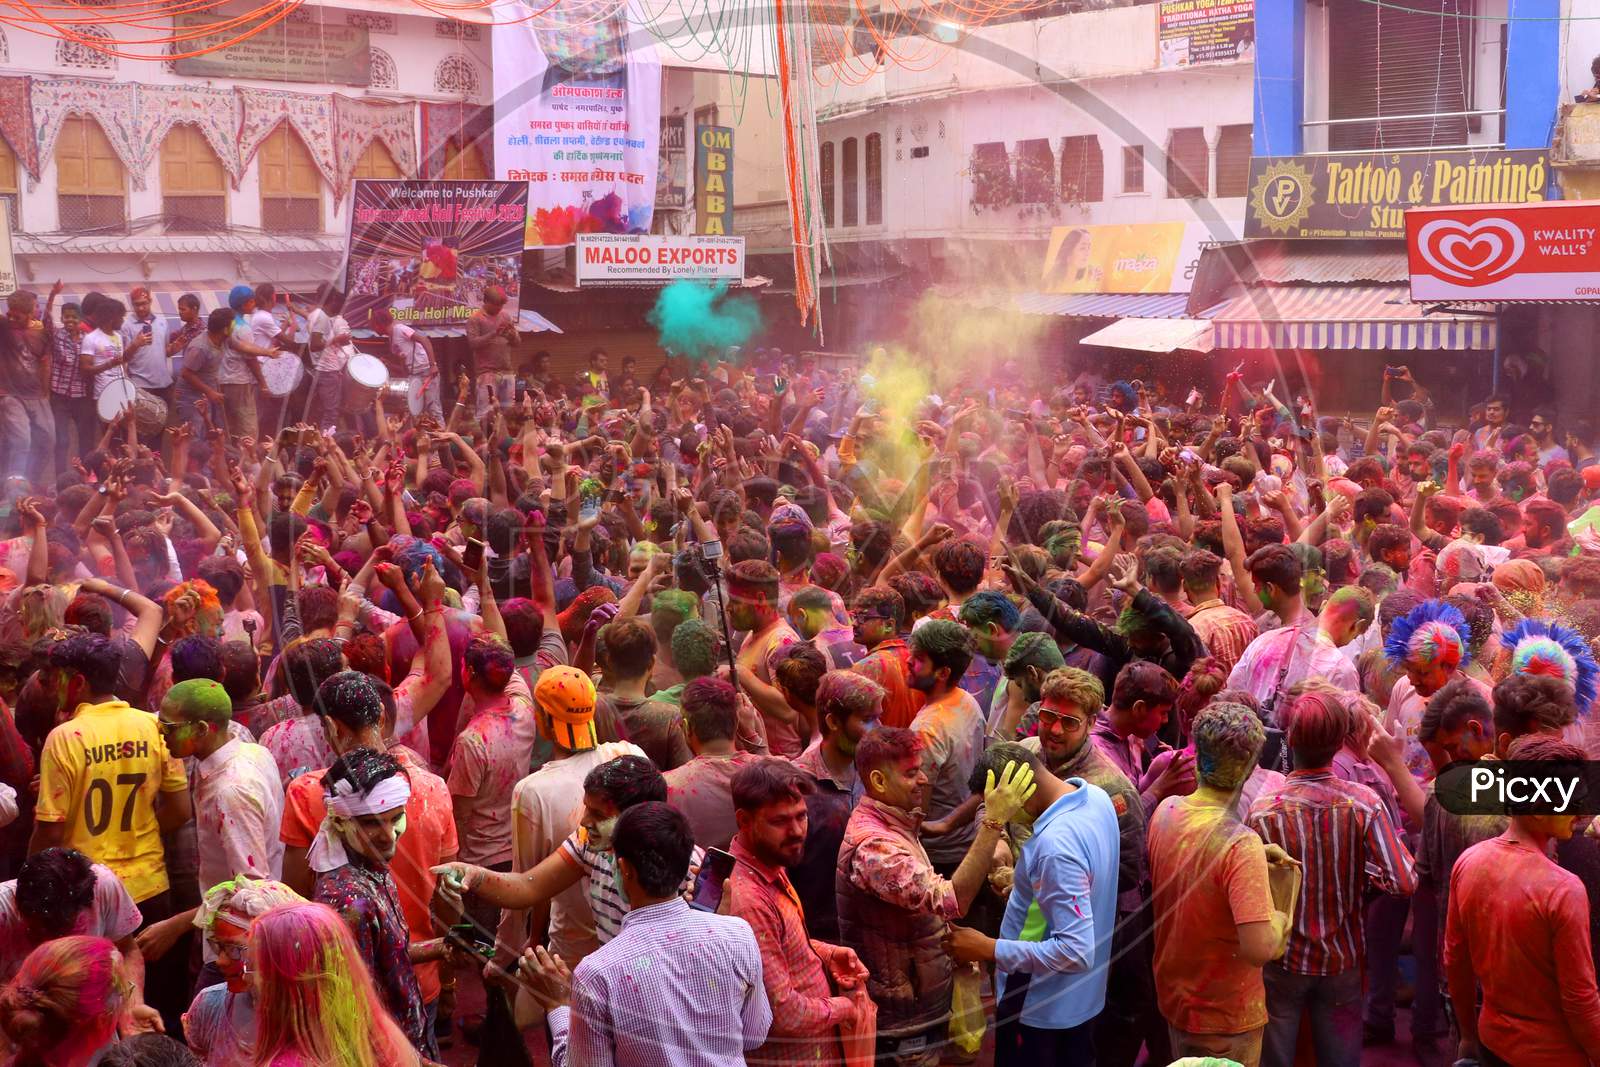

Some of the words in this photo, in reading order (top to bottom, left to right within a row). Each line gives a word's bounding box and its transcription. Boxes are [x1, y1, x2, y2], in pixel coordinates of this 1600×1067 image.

[1161, 1, 1194, 15] PUSHKAR
[1163, 9, 1207, 22] TRADITIONAL
[1209, 6, 1232, 16] HATHA
[1234, 3, 1253, 13] YOGA
[701, 130, 731, 149] OM
[1326, 161, 1402, 205] Tattoo
[1408, 170, 1424, 204] &
[1431, 156, 1545, 204] Painting
[390, 187, 440, 199] Welcome
[442, 187, 452, 198] to
[456, 187, 498, 199] Pushkar
[432, 204, 453, 222] Holi
[455, 204, 497, 222] Festival
[1533, 228, 1596, 241] KWALITY
[585, 247, 652, 264] MALOO
[657, 248, 738, 265] EXPORTS
[607, 266, 661, 274] Recommended
[662, 266, 671, 275] By
[673, 266, 696, 275] Lonely
[697, 266, 718, 274] Planet
[425, 306, 449, 320] Holi
[84, 740, 148, 767] SURESH
[84, 772, 147, 837] 07
